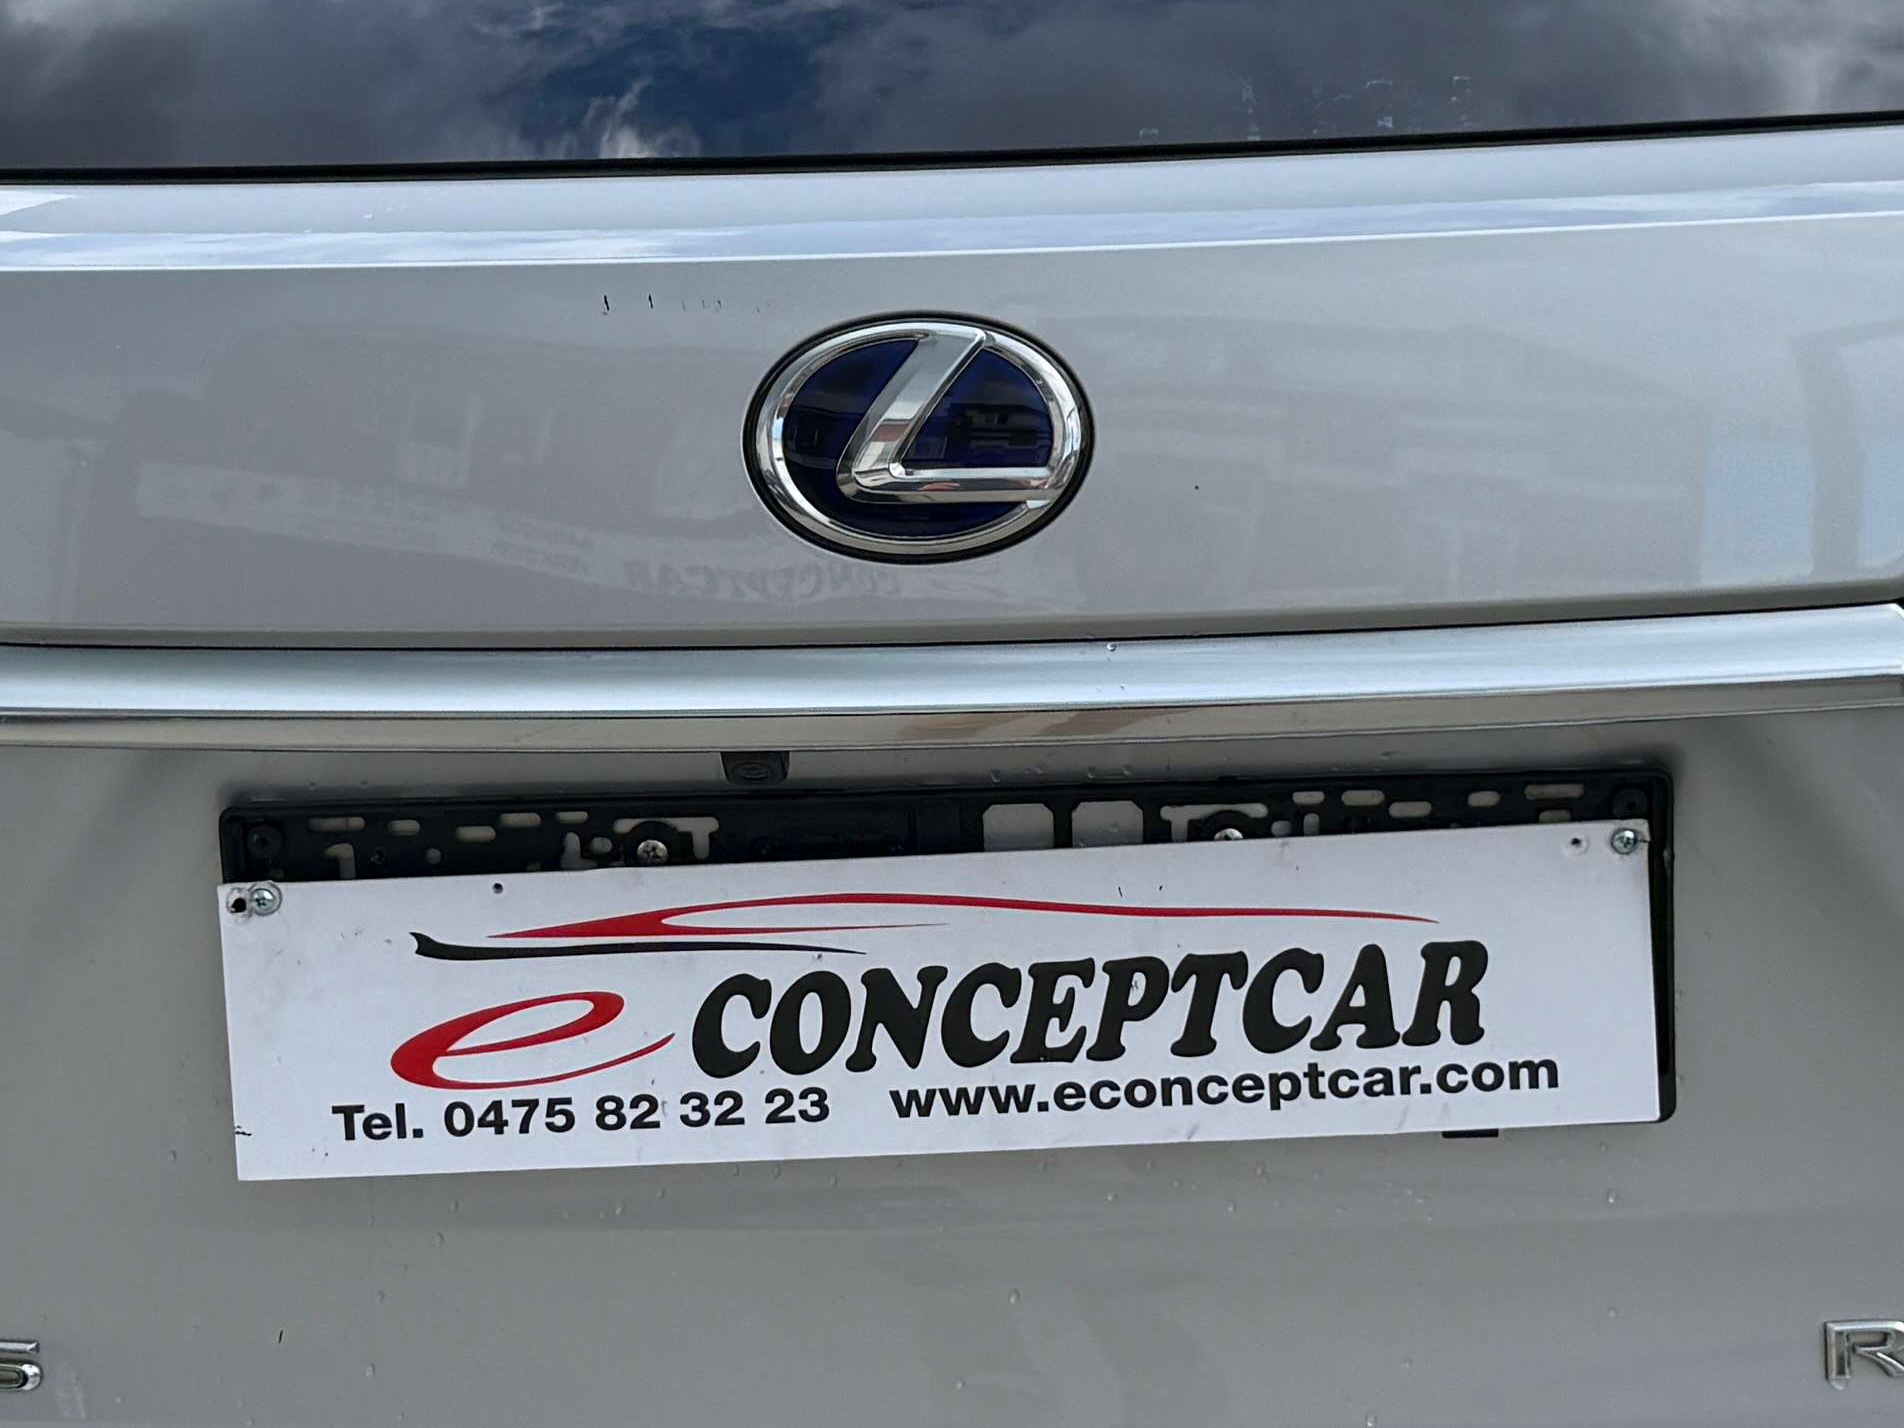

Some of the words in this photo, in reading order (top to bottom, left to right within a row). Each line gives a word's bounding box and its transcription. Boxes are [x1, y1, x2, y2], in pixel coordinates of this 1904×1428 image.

[390, 990, 675, 1090] e
[691, 940, 1489, 1079] CONCEPTCAR
[331, 1103, 424, 1142] Tel.
[443, 1096, 576, 1136] 0475
[594, 1093, 661, 1131] 82
[679, 1089, 746, 1128] 32
[764, 1086, 831, 1125] 23
[889, 1054, 1560, 1119] www.econceptcar.com
